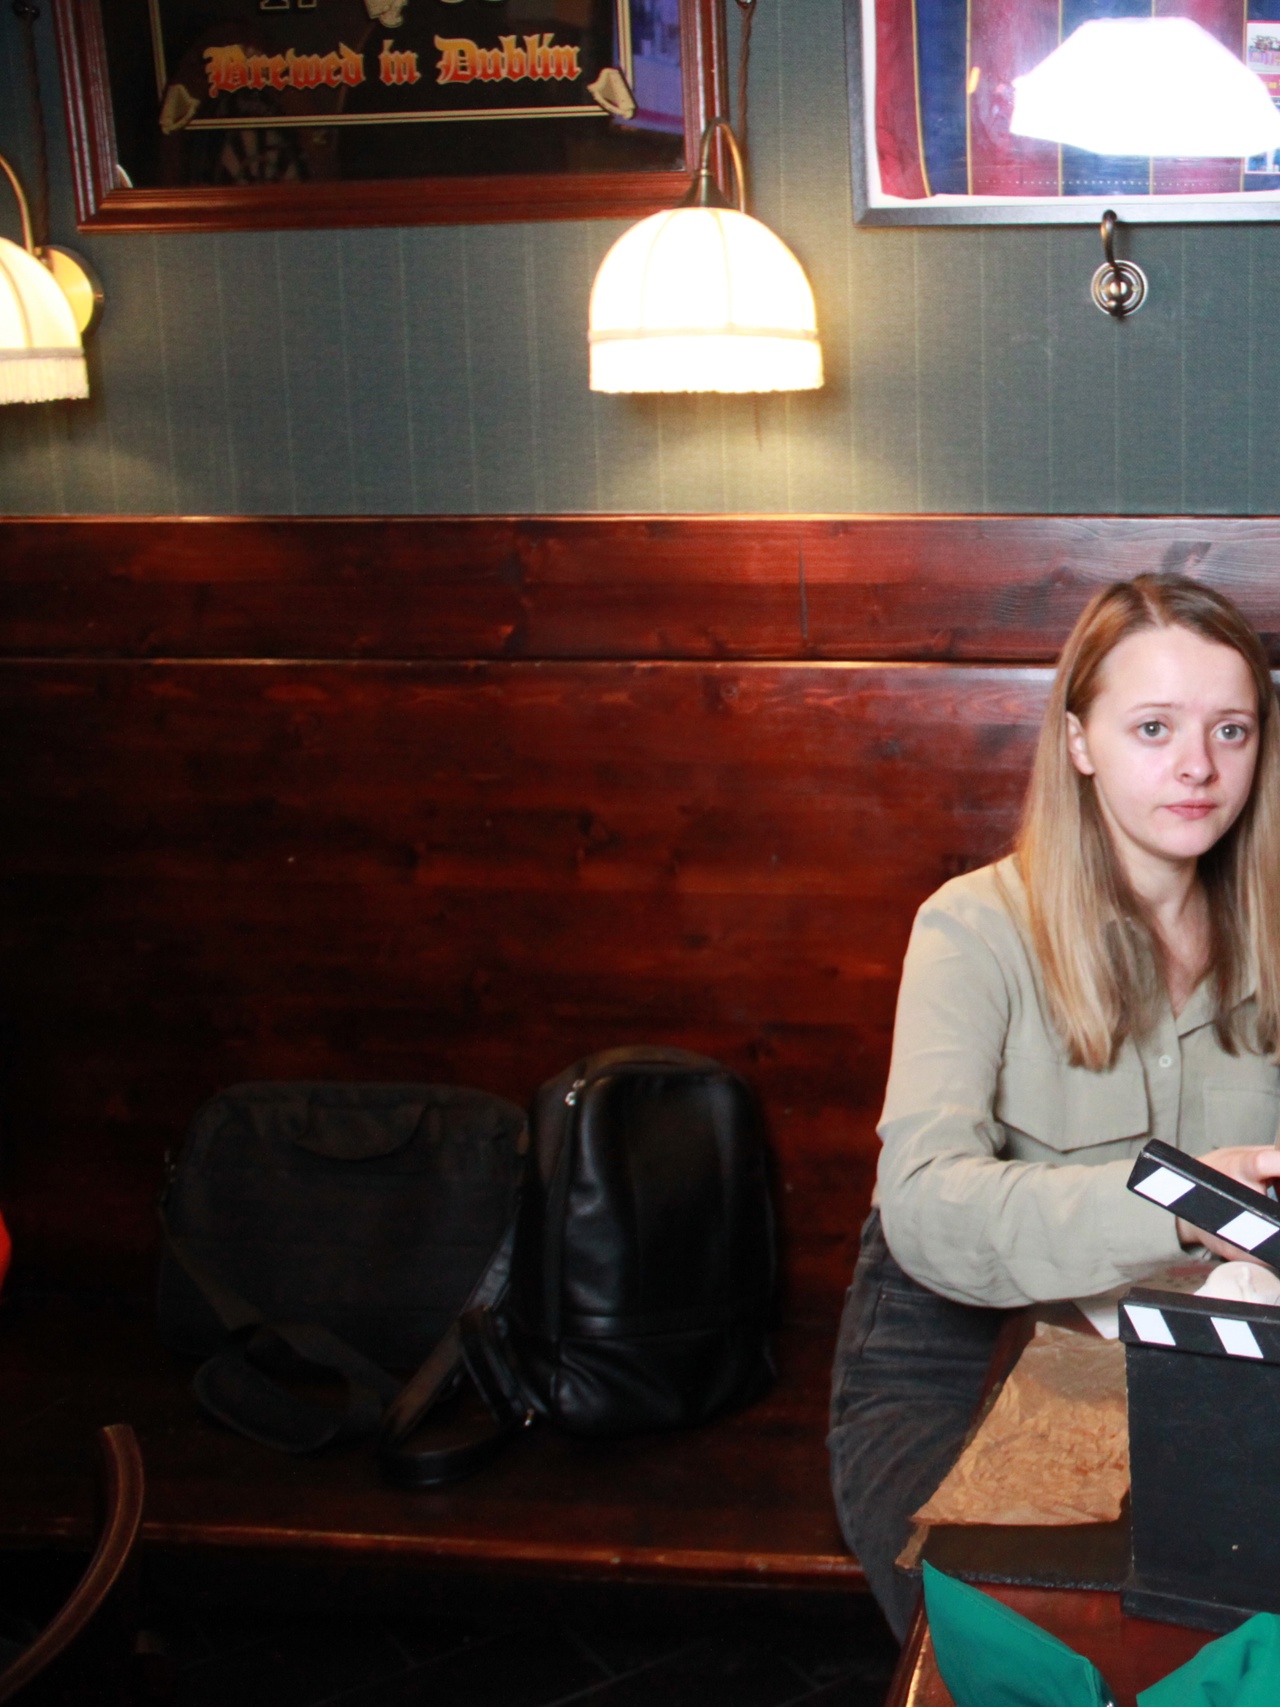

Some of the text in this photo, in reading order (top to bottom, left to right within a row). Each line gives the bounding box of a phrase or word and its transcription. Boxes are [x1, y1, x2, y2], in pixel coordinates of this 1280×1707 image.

[203, 33, 581, 98] Brewed in Dublin
